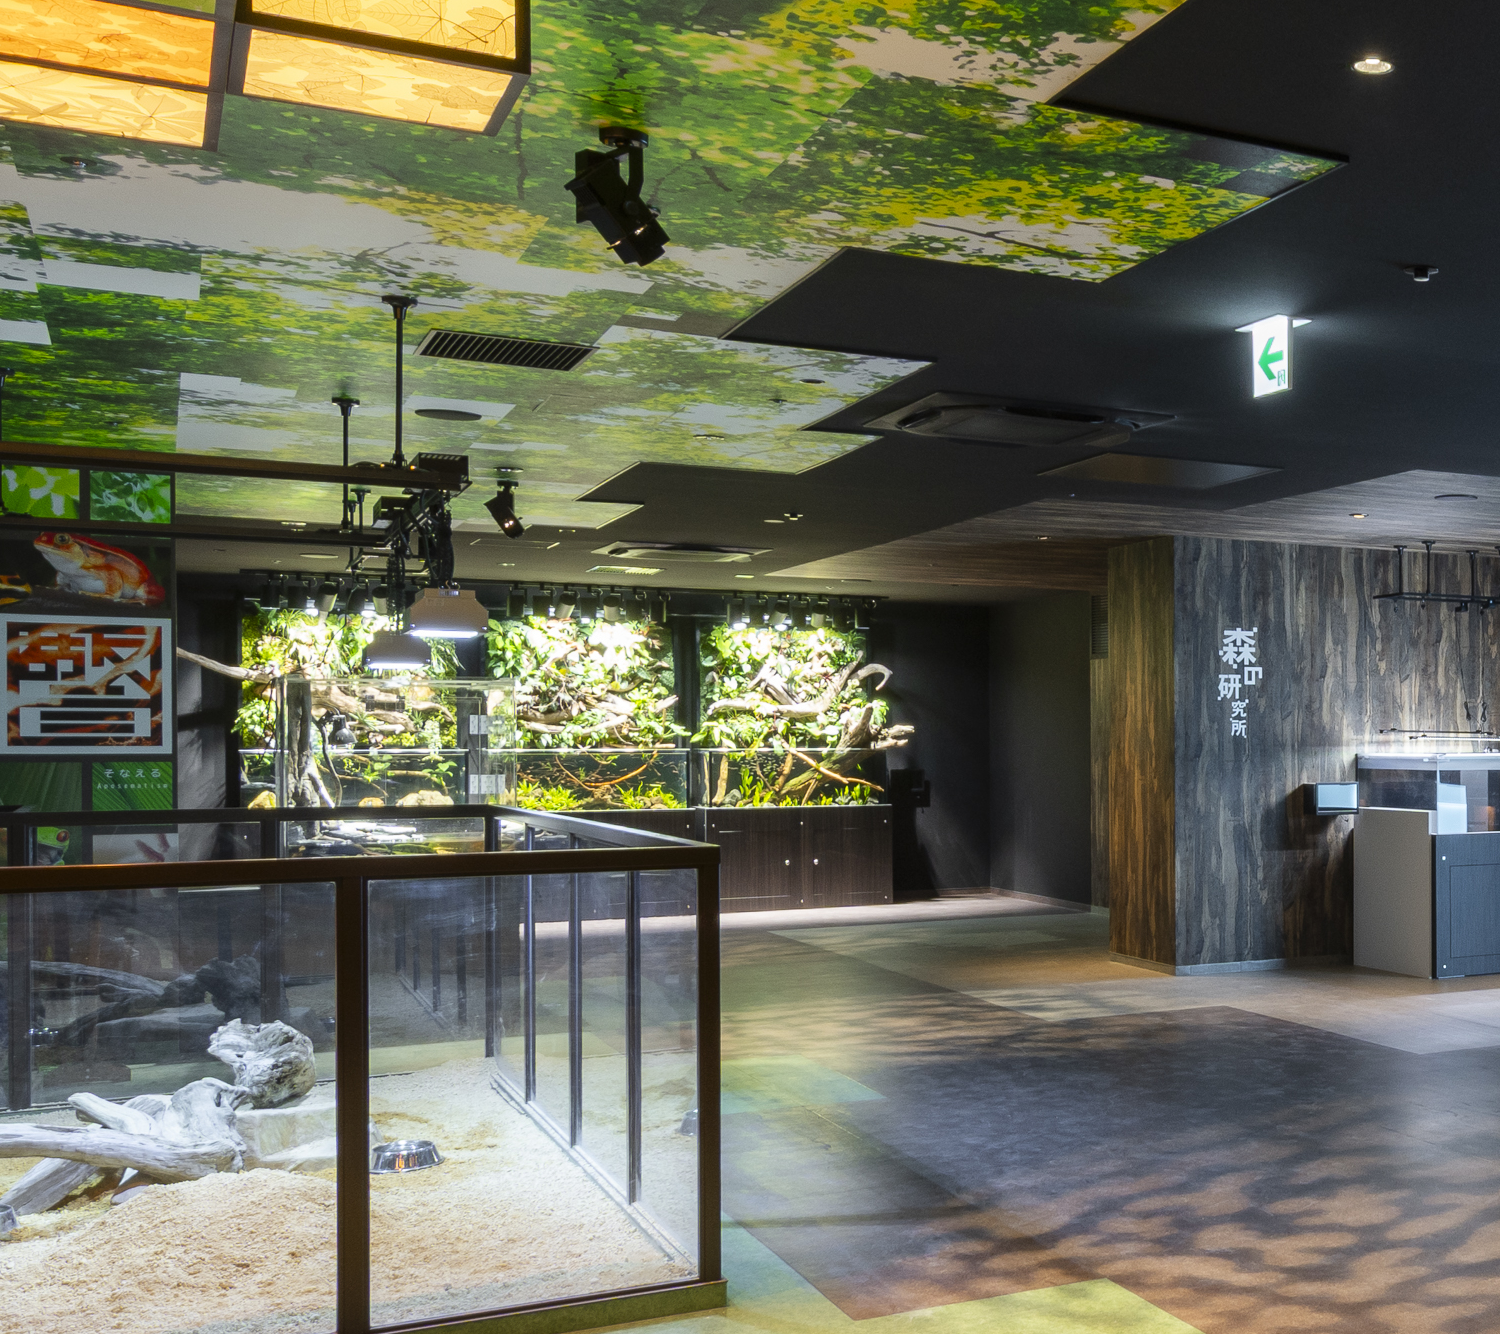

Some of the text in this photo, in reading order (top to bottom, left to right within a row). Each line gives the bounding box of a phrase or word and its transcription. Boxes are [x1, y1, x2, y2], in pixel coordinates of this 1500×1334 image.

[1217, 626, 1263, 739] 森の研究所
[104, 768, 161, 778] そなえる
